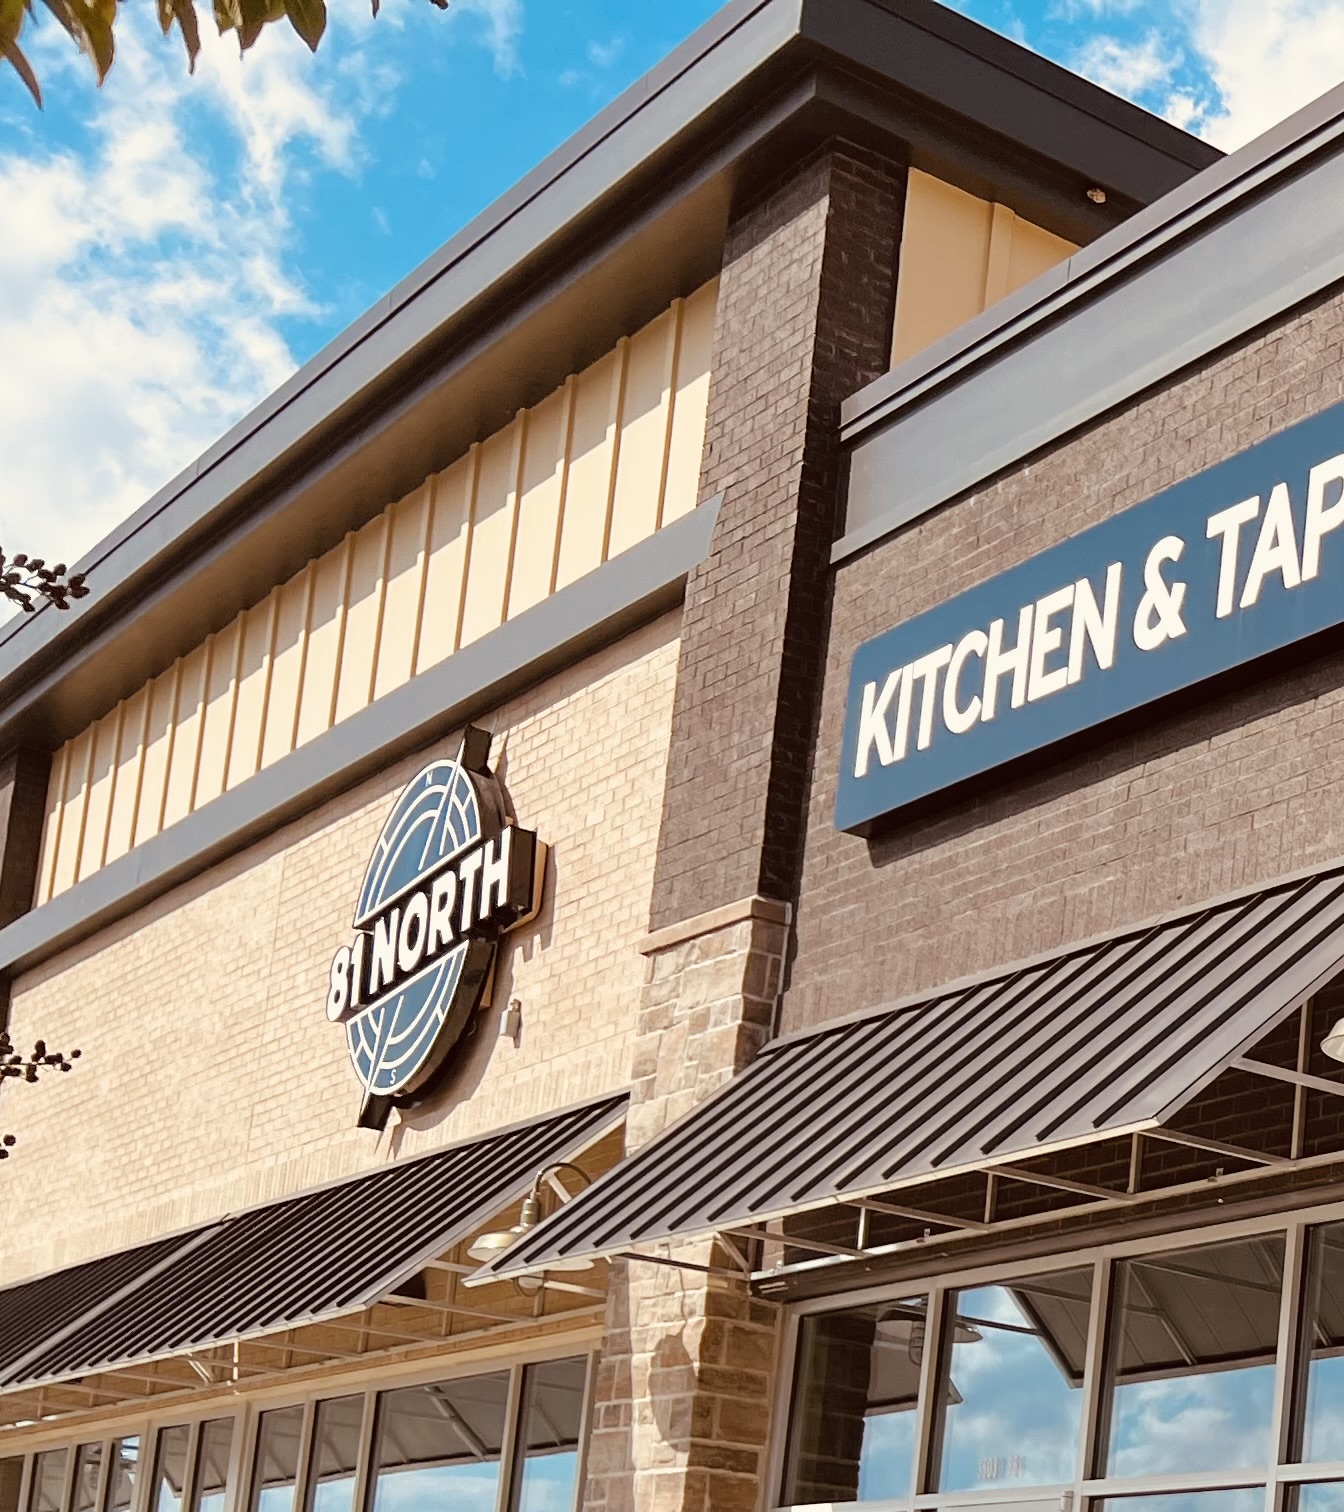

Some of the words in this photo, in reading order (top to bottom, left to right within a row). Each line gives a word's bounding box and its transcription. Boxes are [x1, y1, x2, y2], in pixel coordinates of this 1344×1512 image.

[854, 561, 1122, 779] KITCHEN
[1133, 535, 1187, 651] &
[425, 770, 434, 787] N
[327, 935, 364, 1021] 81
[369, 829, 512, 995] NORTH
[389, 1068, 397, 1085] S
